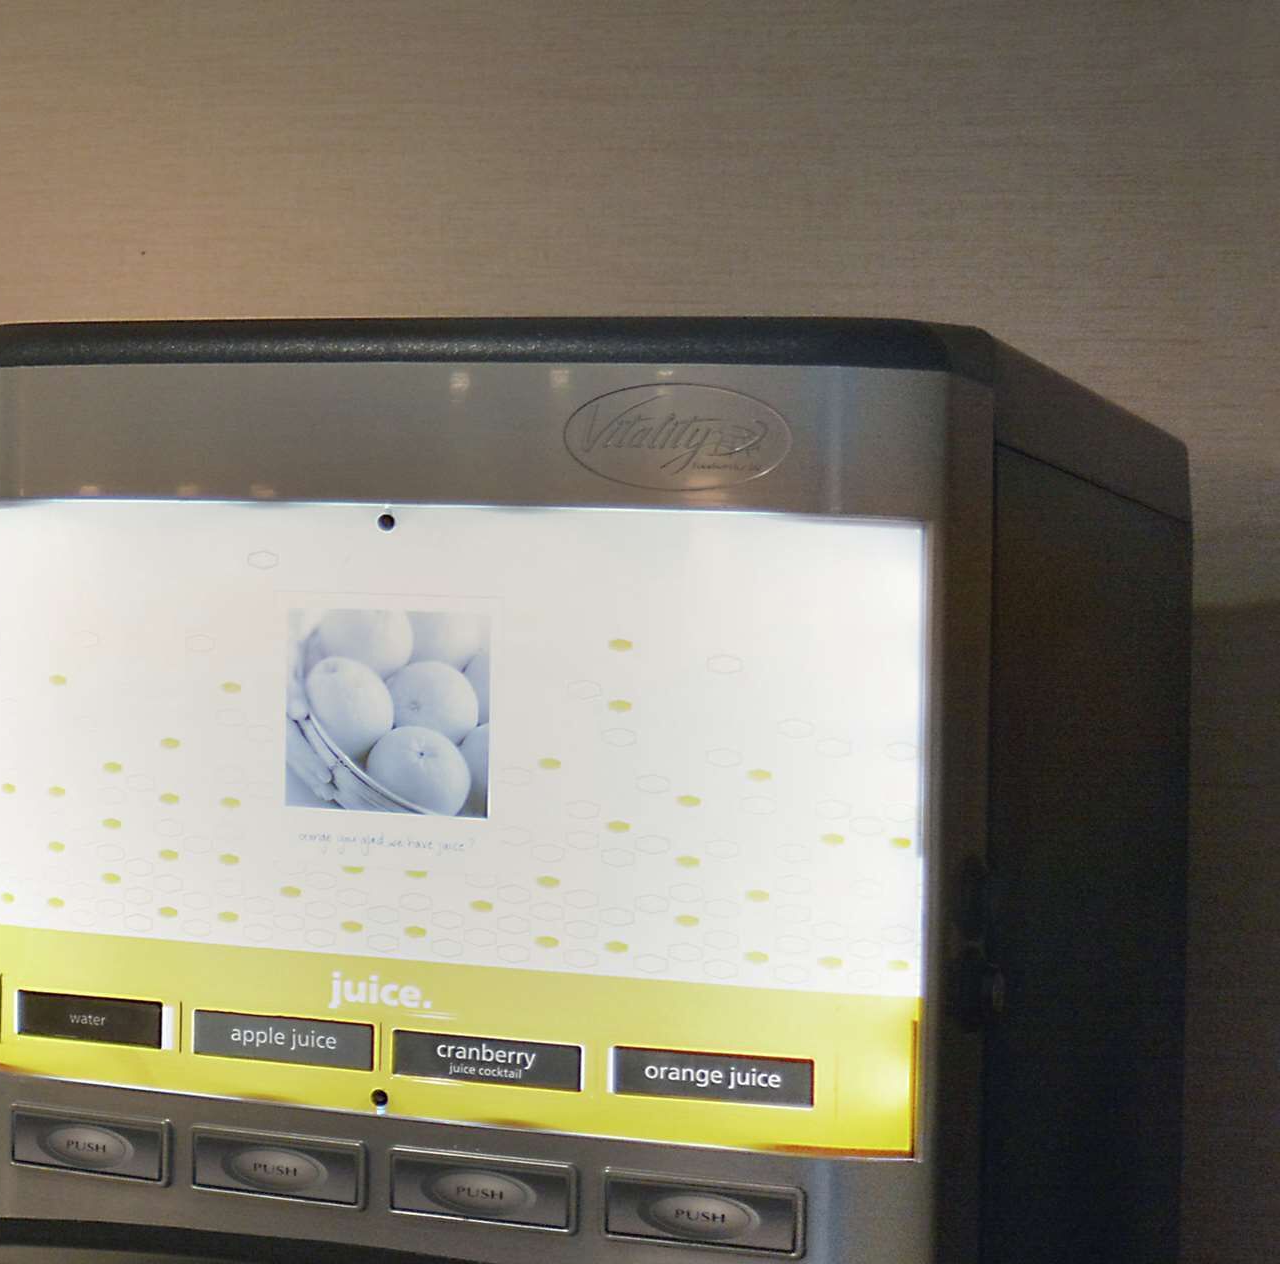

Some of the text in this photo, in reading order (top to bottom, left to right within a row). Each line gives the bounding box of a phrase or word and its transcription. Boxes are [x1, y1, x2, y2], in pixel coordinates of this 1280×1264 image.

[407, 836, 434, 850] have
[328, 971, 433, 1009] juice.
[69, 1011, 106, 1027] water
[230, 1025, 338, 1051] apple juice
[436, 1041, 536, 1070] cranberry
[448, 1063, 523, 1080] juice cocktail
[644, 1062, 782, 1090] orange juice
[65, 1138, 108, 1155] PUSH
[252, 1160, 299, 1178] PUSH
[455, 1184, 505, 1202] PUSH
[673, 1207, 726, 1225] PUSH
